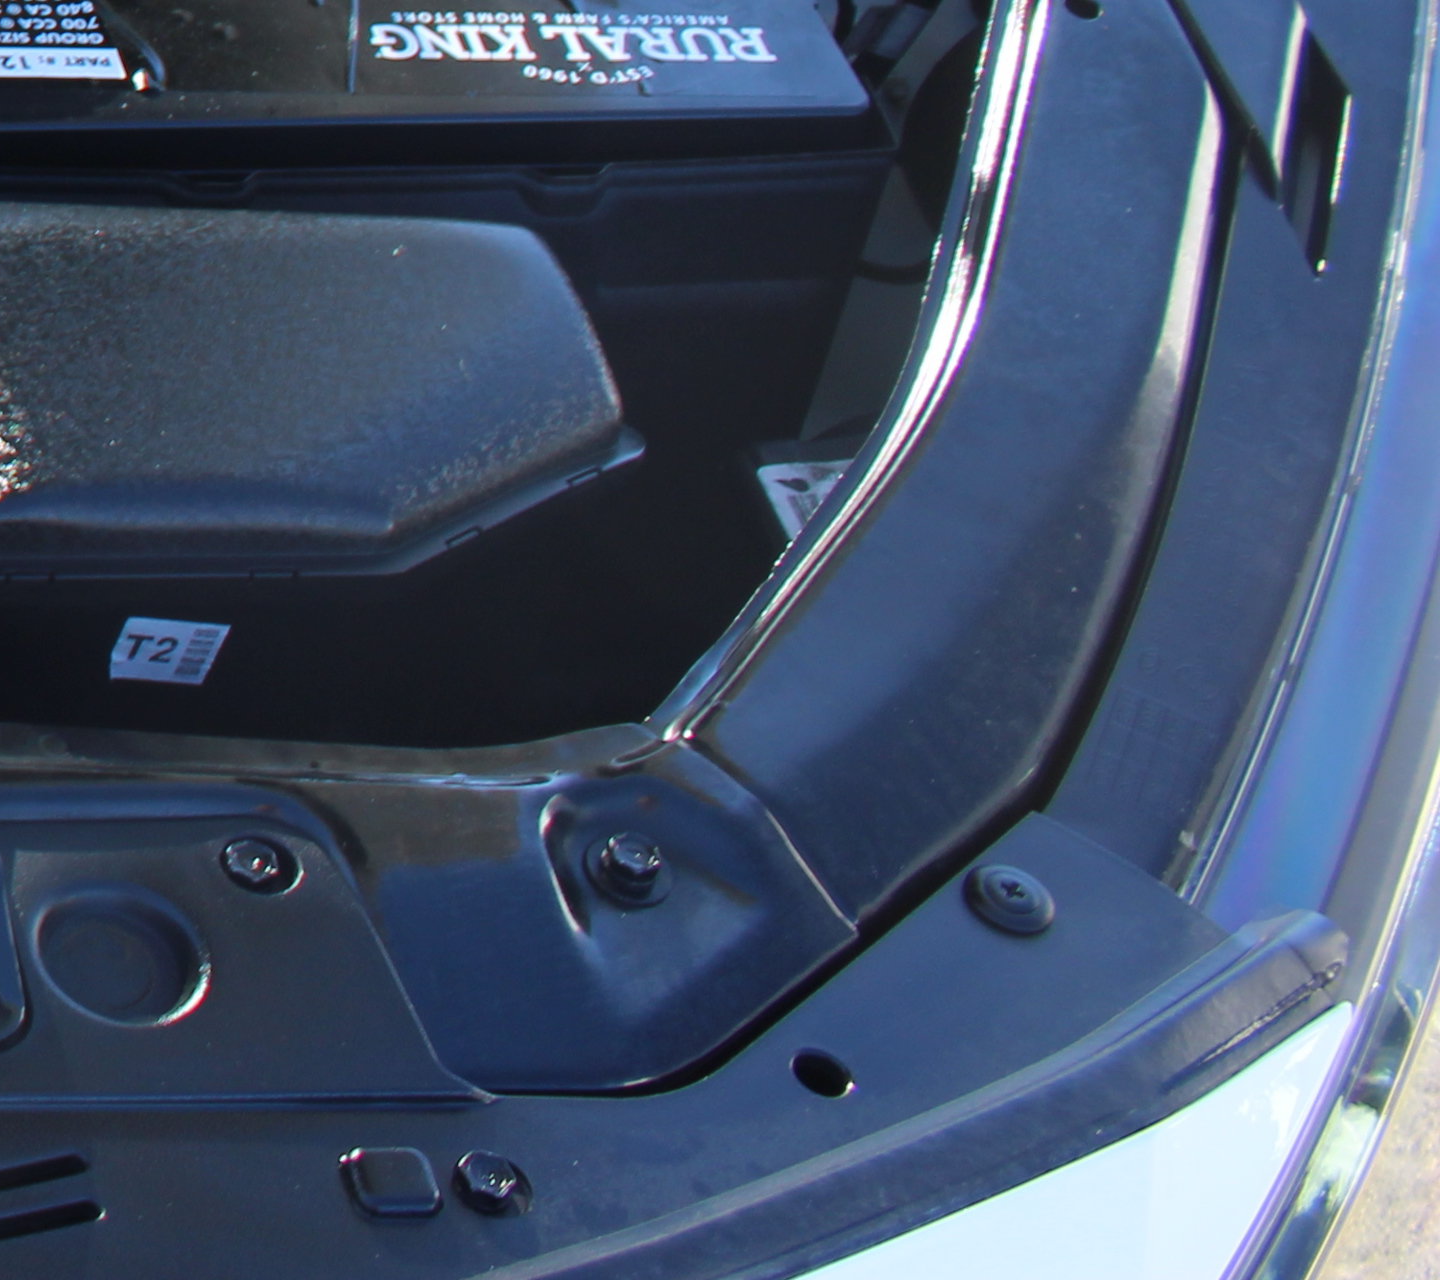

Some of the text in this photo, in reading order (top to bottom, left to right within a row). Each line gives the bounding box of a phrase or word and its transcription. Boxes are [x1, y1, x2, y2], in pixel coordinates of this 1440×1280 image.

[24, 2, 53, 16] CA
[17, 18, 58, 30] CCA
[60, 15, 101, 30] 700
[391, 10, 459, 24] STORE
[463, 11, 526, 24] HOME
[532, 12, 548, 24] &
[553, 11, 612, 25] FARM
[34, 31, 105, 45] GROUP
[369, 23, 779, 62] RURAL KING
[64, 55, 113, 68] PART
[522, 64, 582, 85] 1960
[126, 633, 179, 663] T2
